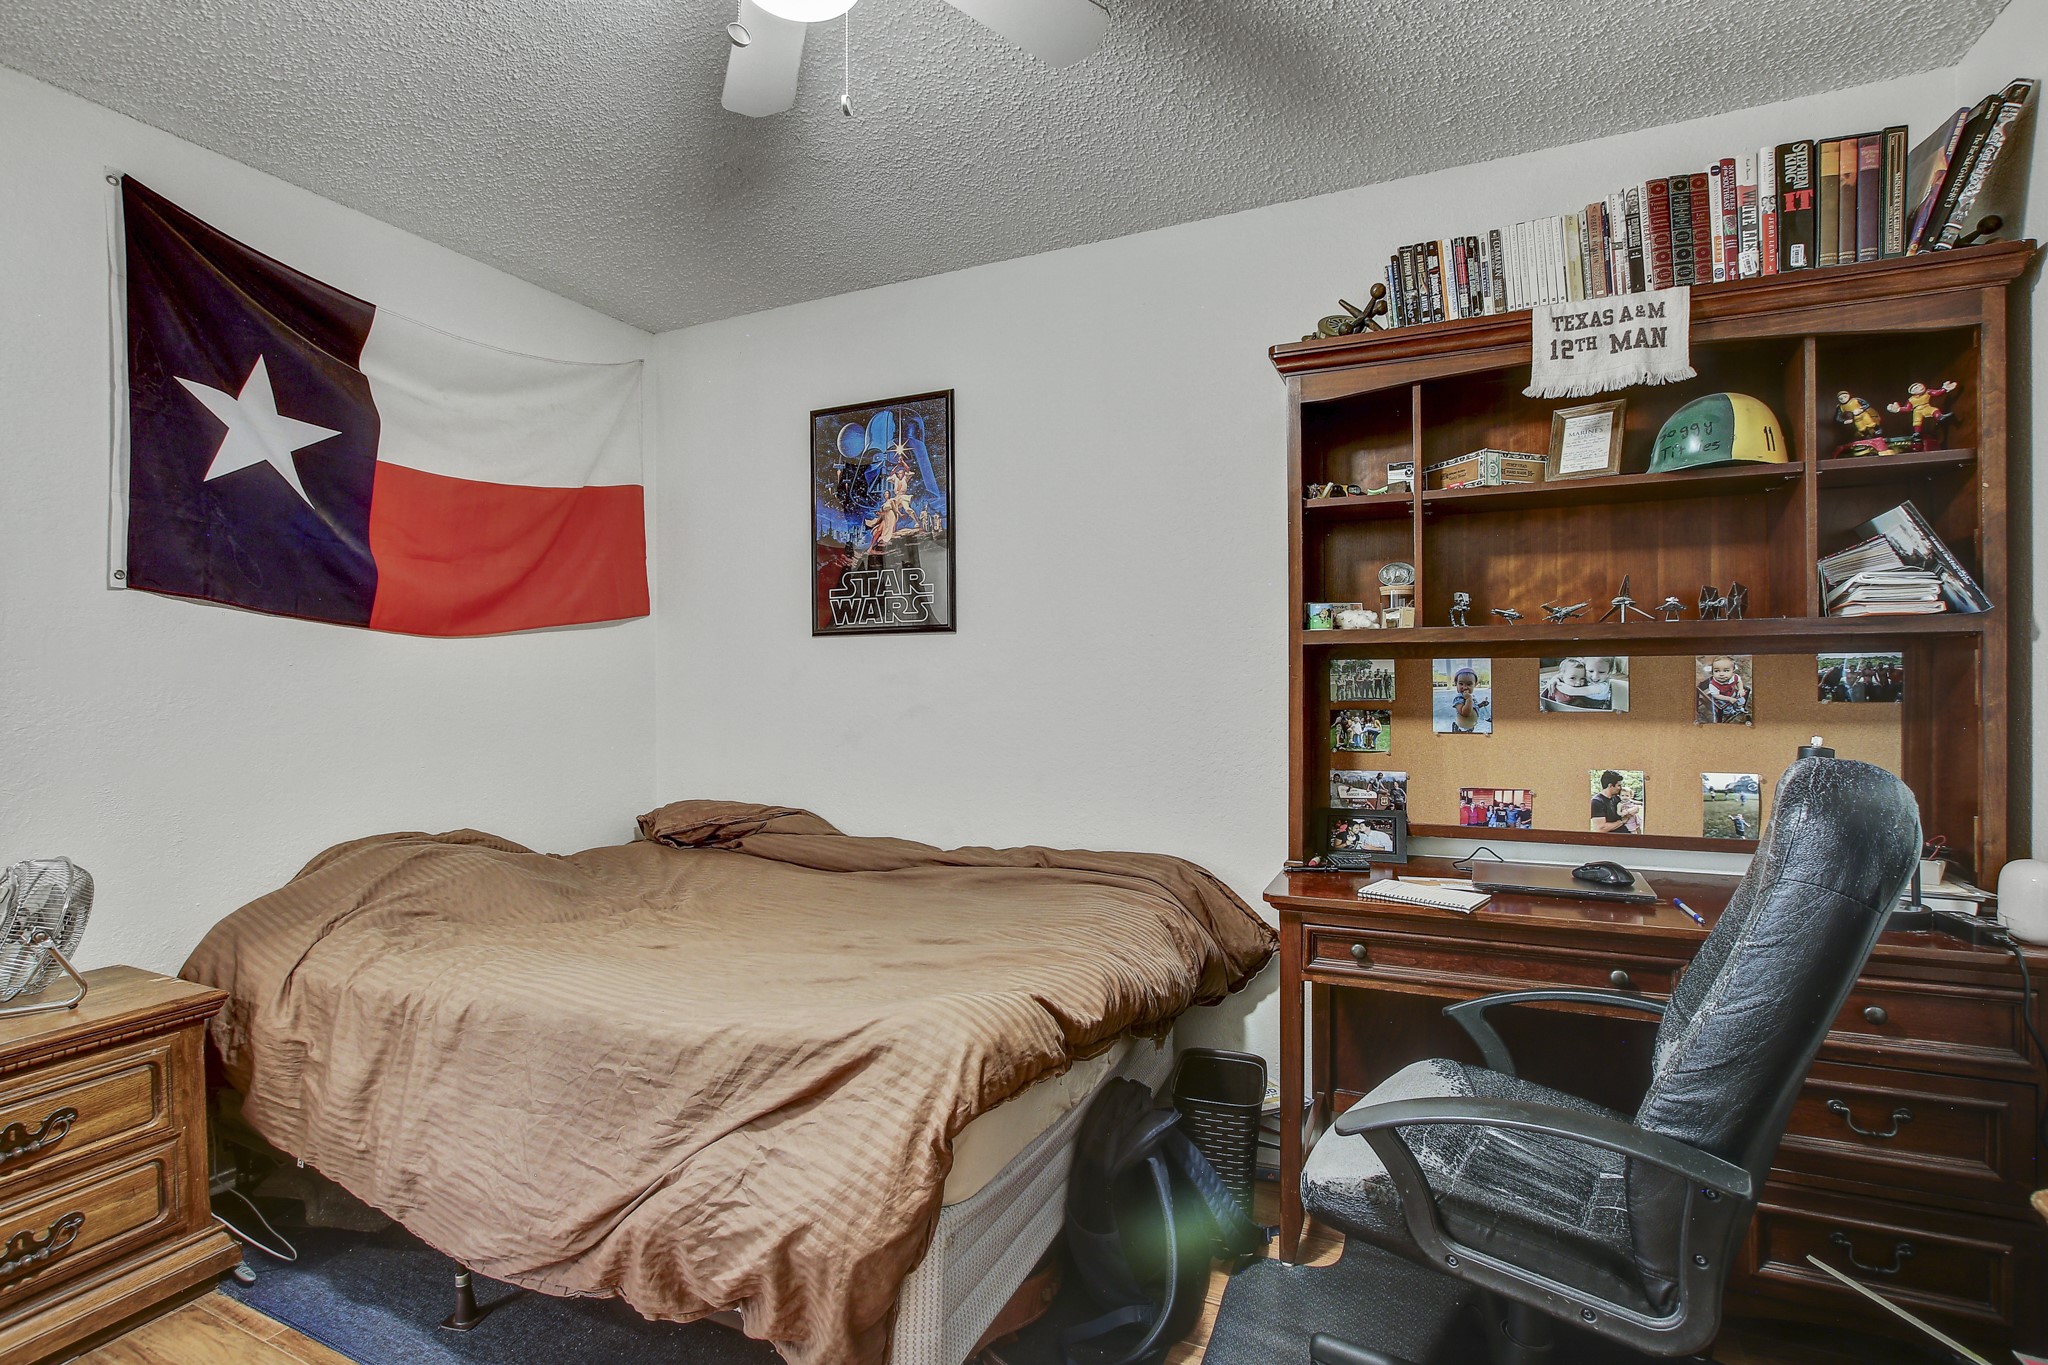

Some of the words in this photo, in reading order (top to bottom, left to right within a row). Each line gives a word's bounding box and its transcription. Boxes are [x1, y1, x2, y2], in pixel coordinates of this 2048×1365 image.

[1985, 102, 1998, 120] Larson
[1968, 145, 1977, 156] Far
[1972, 134, 1984, 144] The
[1784, 154, 1797, 183] KING
[1792, 143, 1809, 189] STEPHEN
[1963, 153, 1973, 167] Side
[1948, 166, 1967, 203] GALLERY
[1740, 190, 1757, 226] WHITE
[1784, 189, 1813, 212] IT
[1631, 218, 1640, 247] EMPIRE
[1742, 230, 1758, 252] LIES
[1403, 252, 1412, 275] STEPHEN
[1493, 241, 1502, 277] COMMUNION
[1406, 276, 1414, 290] KING
[1406, 293, 1415, 318] SHINING
[1552, 309, 1614, 332] TEXAS
[1619, 302, 1666, 323] A&M
[1550, 336, 1597, 360] 12TH
[1609, 327, 1667, 354] MAN
[1569, 428, 1603, 437] MARINES
[1763, 426, 1776, 451] 11
[1660, 440, 1720, 461] Tities
[829, 567, 934, 599] STAR
[830, 595, 934, 626] WARS
